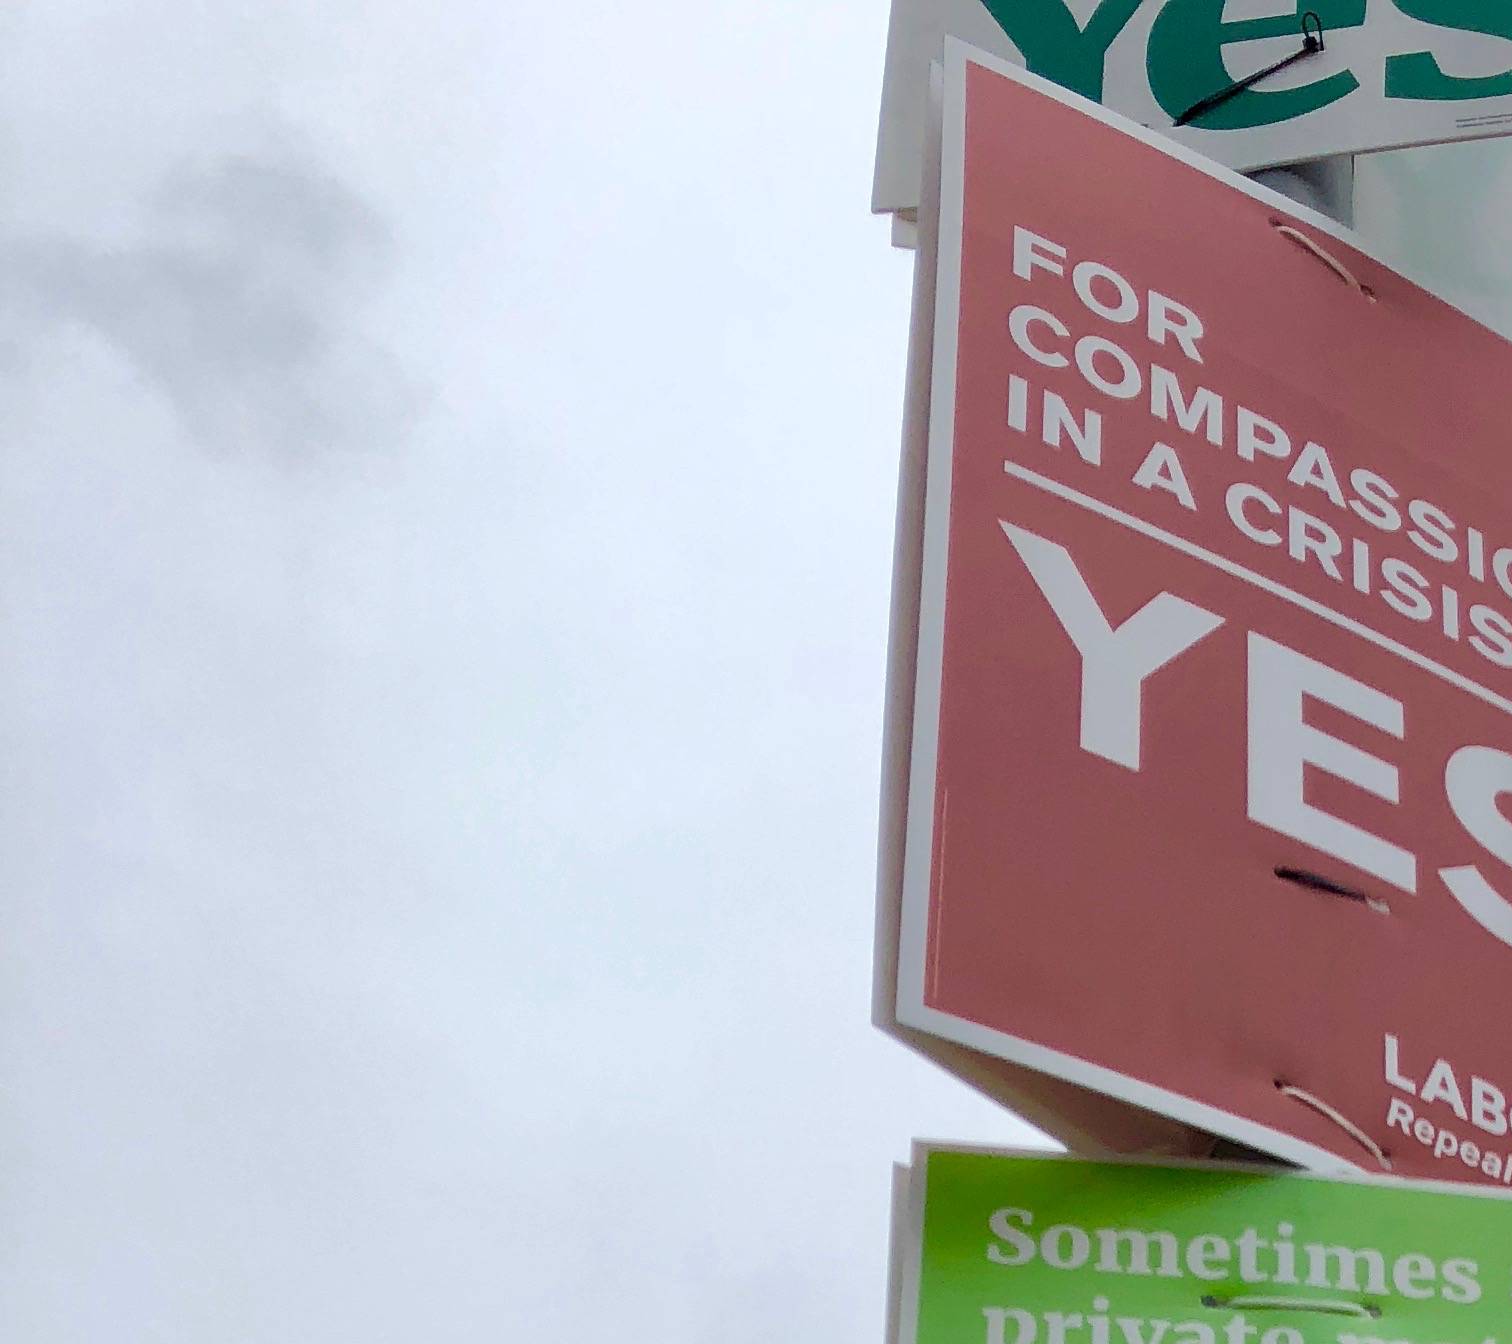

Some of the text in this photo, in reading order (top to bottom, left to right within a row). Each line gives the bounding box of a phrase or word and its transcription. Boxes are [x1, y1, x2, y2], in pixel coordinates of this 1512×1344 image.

[1012, 226, 1204, 364] FOR
[1007, 374, 1102, 467] IN
[1132, 446, 1198, 512] A
[986, 1208, 1482, 1305] Sometimes
